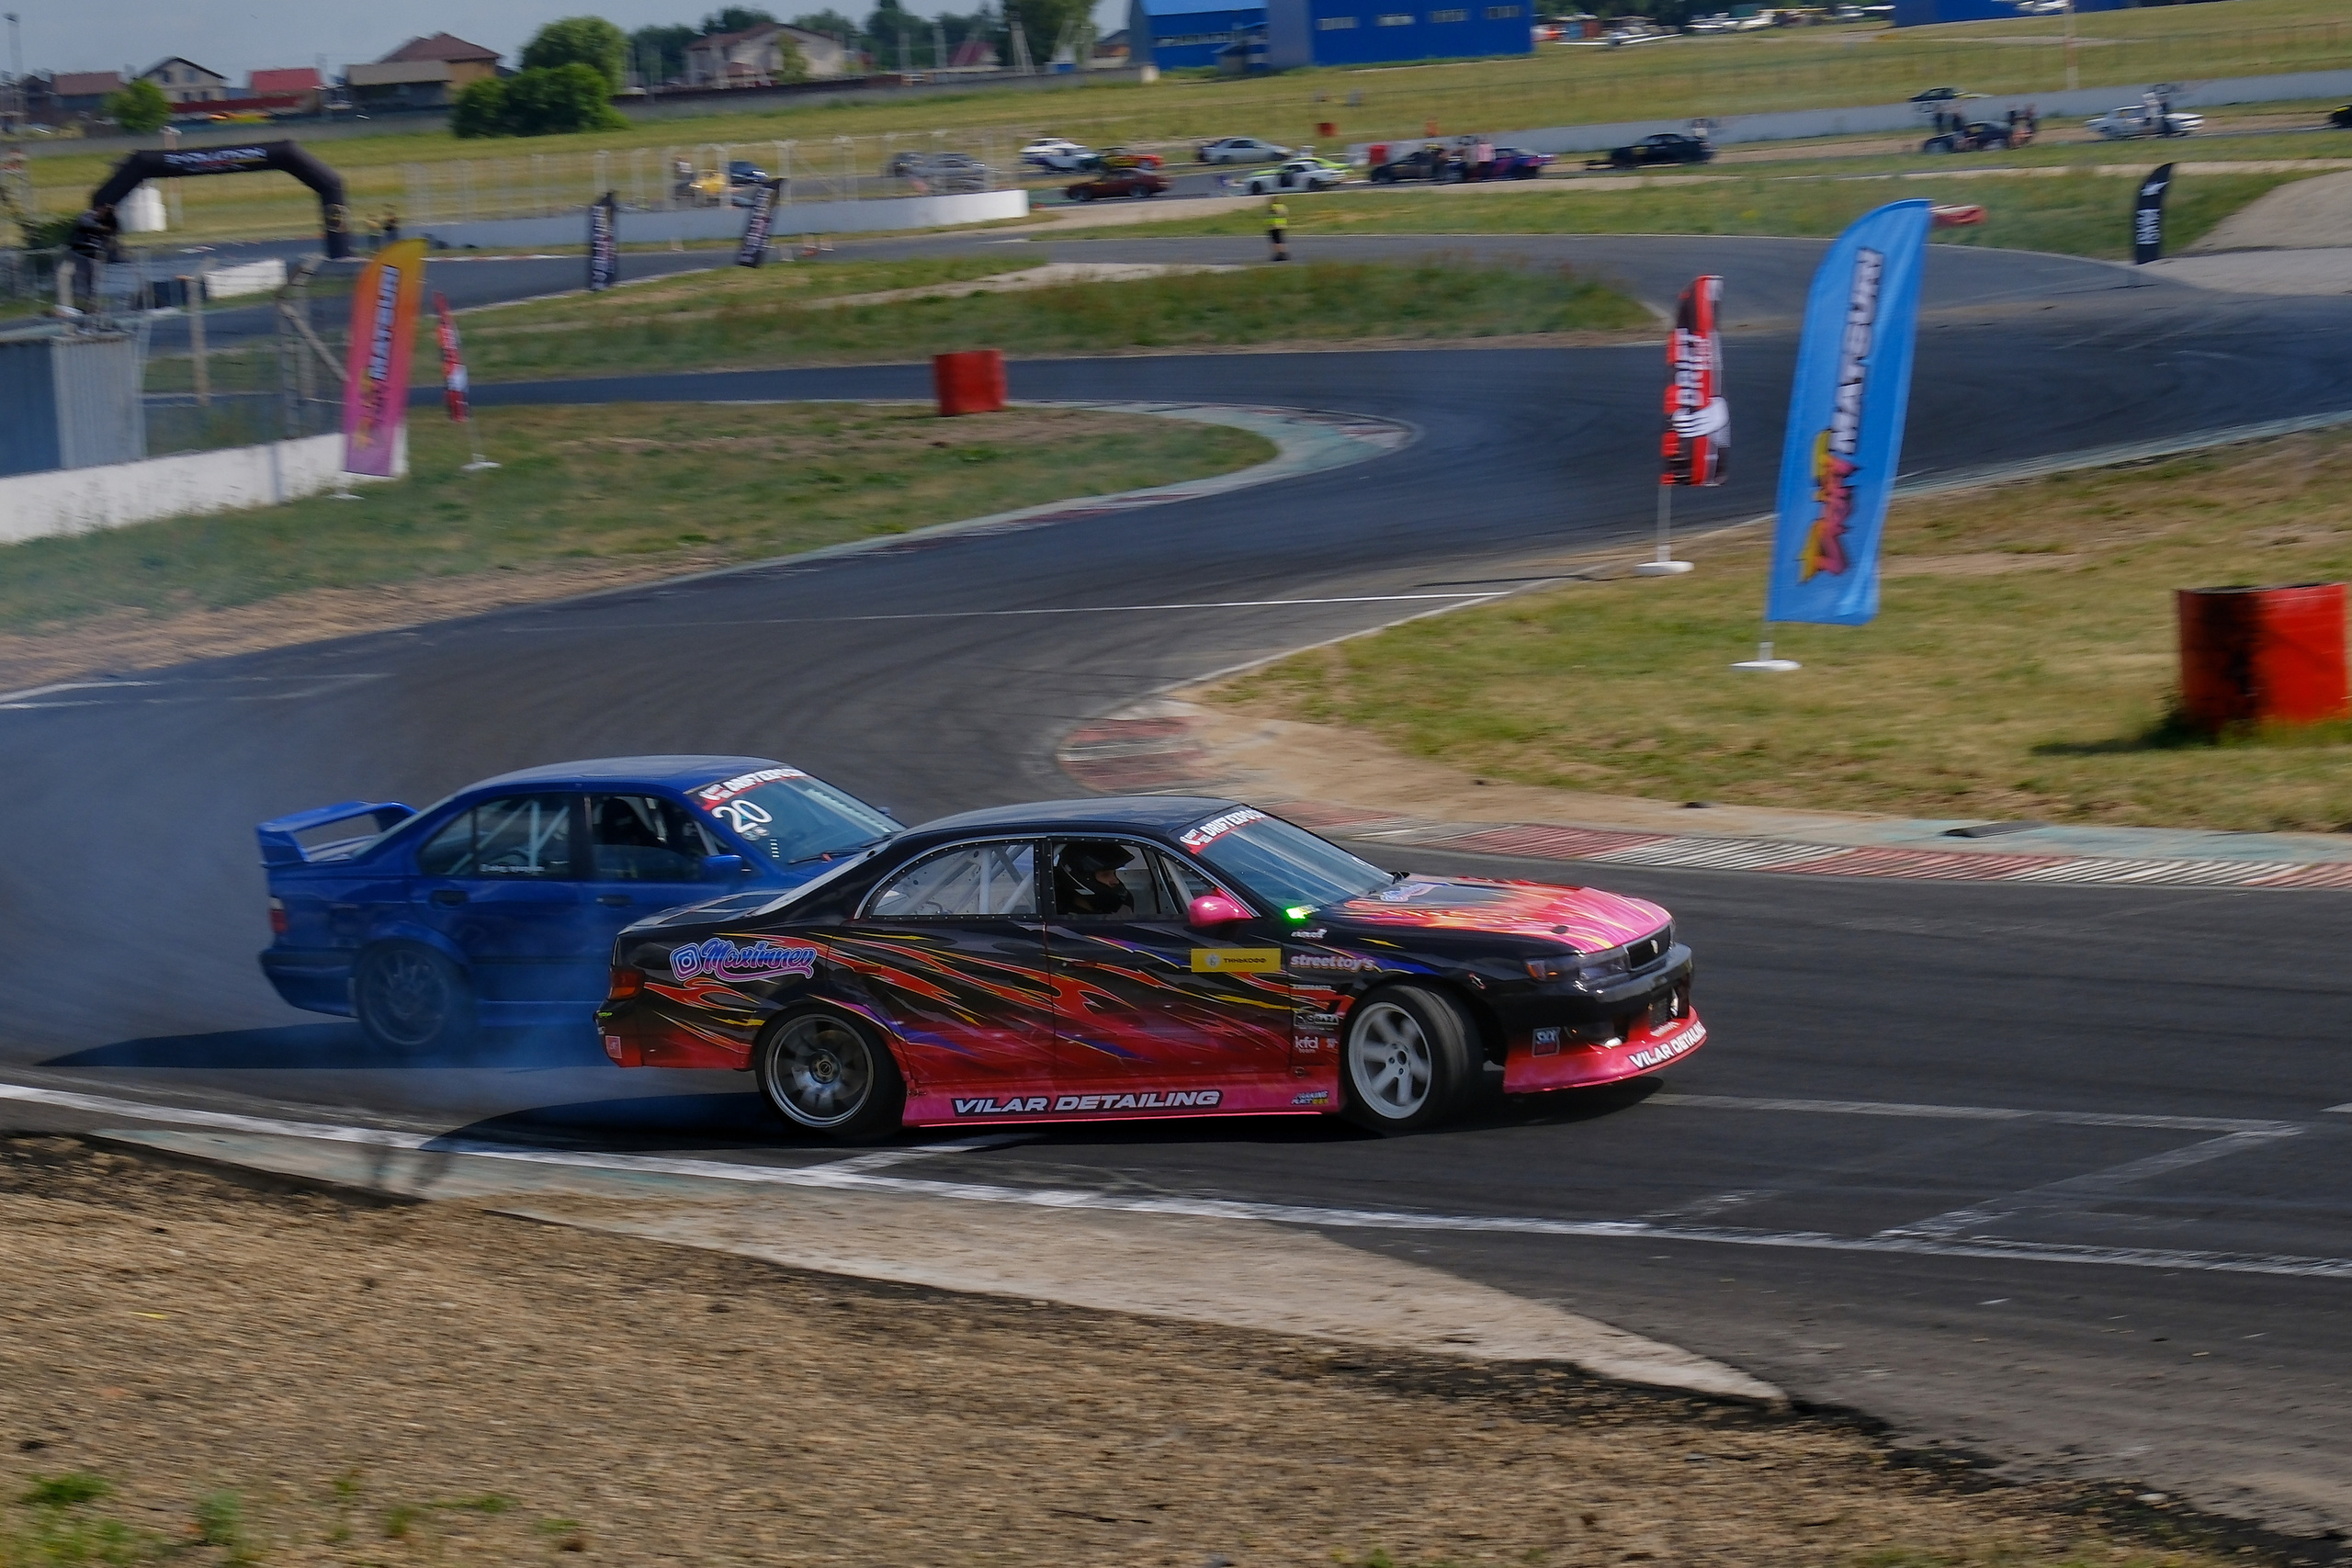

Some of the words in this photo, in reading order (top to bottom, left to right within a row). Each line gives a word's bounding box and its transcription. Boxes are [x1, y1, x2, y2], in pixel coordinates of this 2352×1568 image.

[711, 799, 773, 834] 20
[1200, 816, 1235, 837] DRIFT
[1295, 1035, 1318, 1049] kfd
[1629, 1046, 1676, 1069] VILAR
[955, 1098, 1047, 1113] VILAR
[1055, 1090, 1221, 1111] DETAILING
